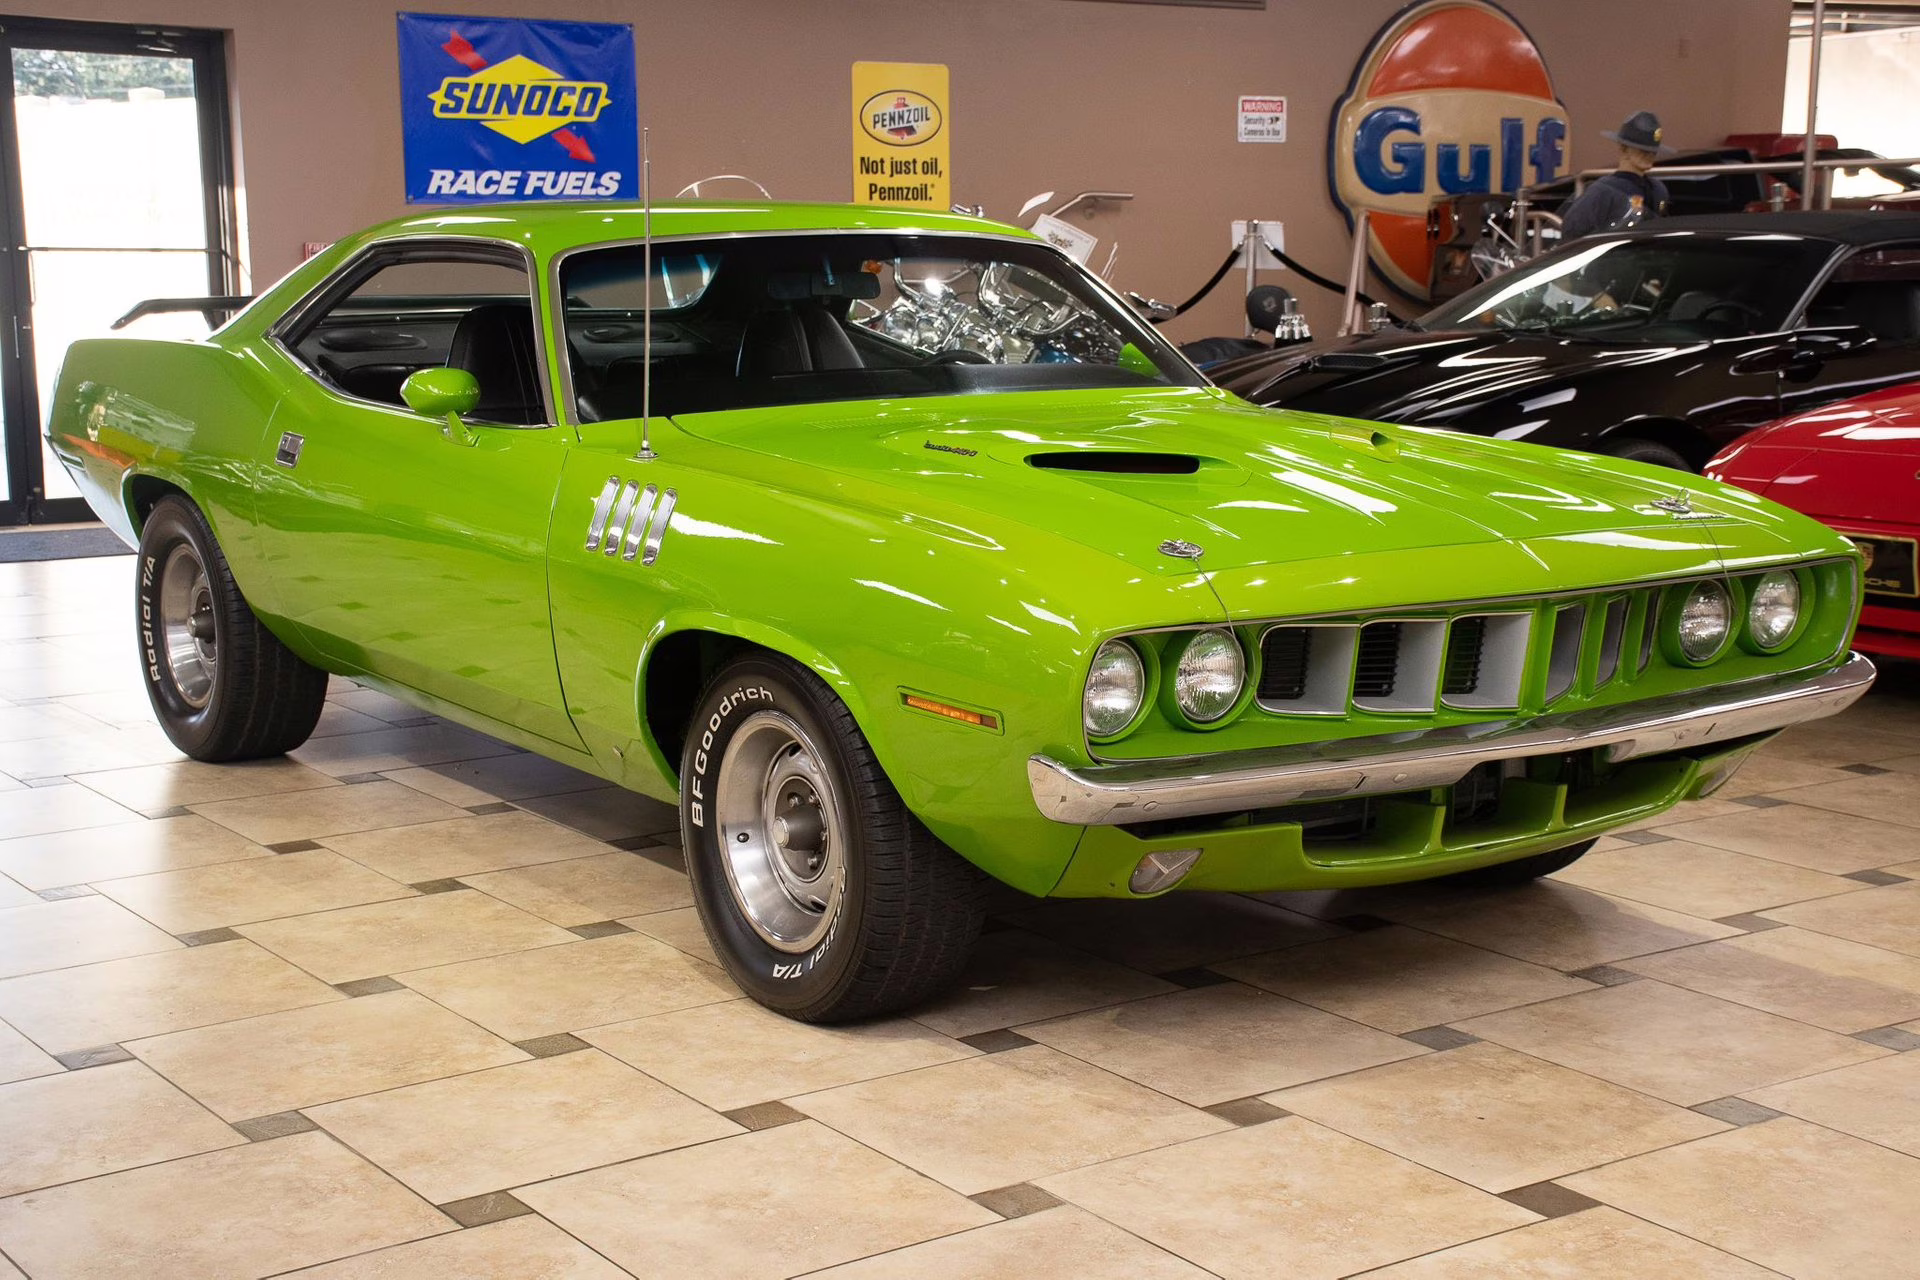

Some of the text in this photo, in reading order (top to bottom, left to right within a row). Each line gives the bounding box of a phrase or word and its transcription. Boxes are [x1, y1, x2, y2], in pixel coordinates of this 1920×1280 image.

[439, 82, 602, 117] SUNOCO
[1243, 101, 1282, 112] WARNING
[873, 106, 931, 130] PENNZOIL
[1353, 106, 1566, 195] Gulf
[860, 156, 943, 178] Not just oil,
[427, 169, 622, 196] RACE FUELS
[142, 556, 161, 681] Radial T/A
[691, 686, 776, 828] BFGoodrich
[772, 963, 803, 980] T/A
